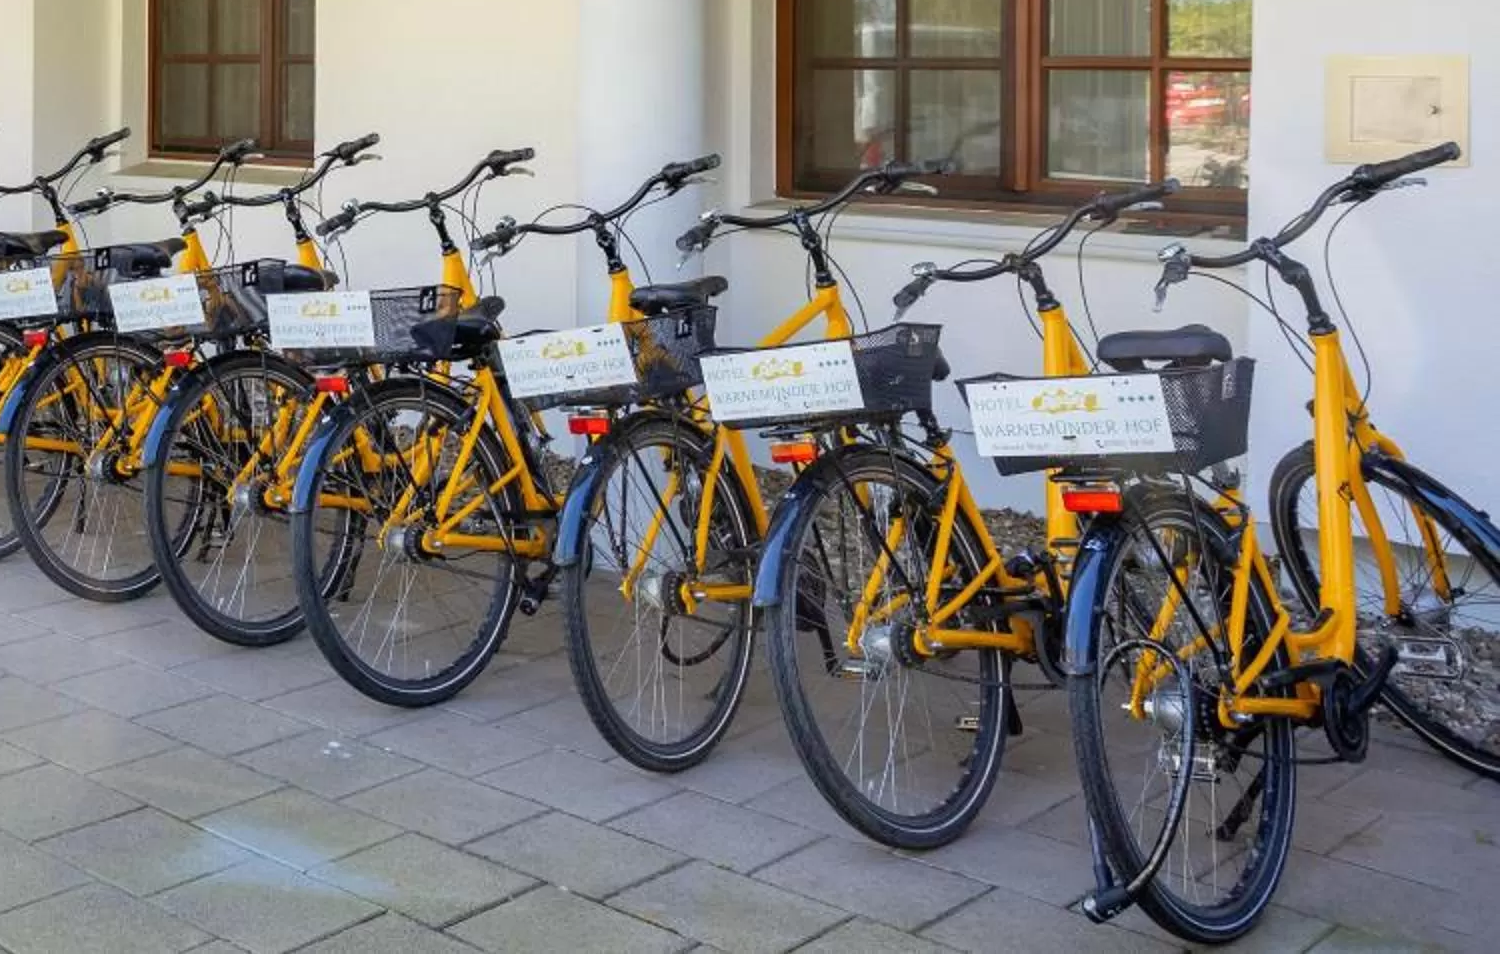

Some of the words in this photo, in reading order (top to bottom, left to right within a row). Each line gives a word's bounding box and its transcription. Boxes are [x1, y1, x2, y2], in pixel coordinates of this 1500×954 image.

[972, 397, 1025, 412] HOTEL
[978, 418, 1117, 439] WARNEMÜNDER
[1125, 417, 1164, 434] HOF
